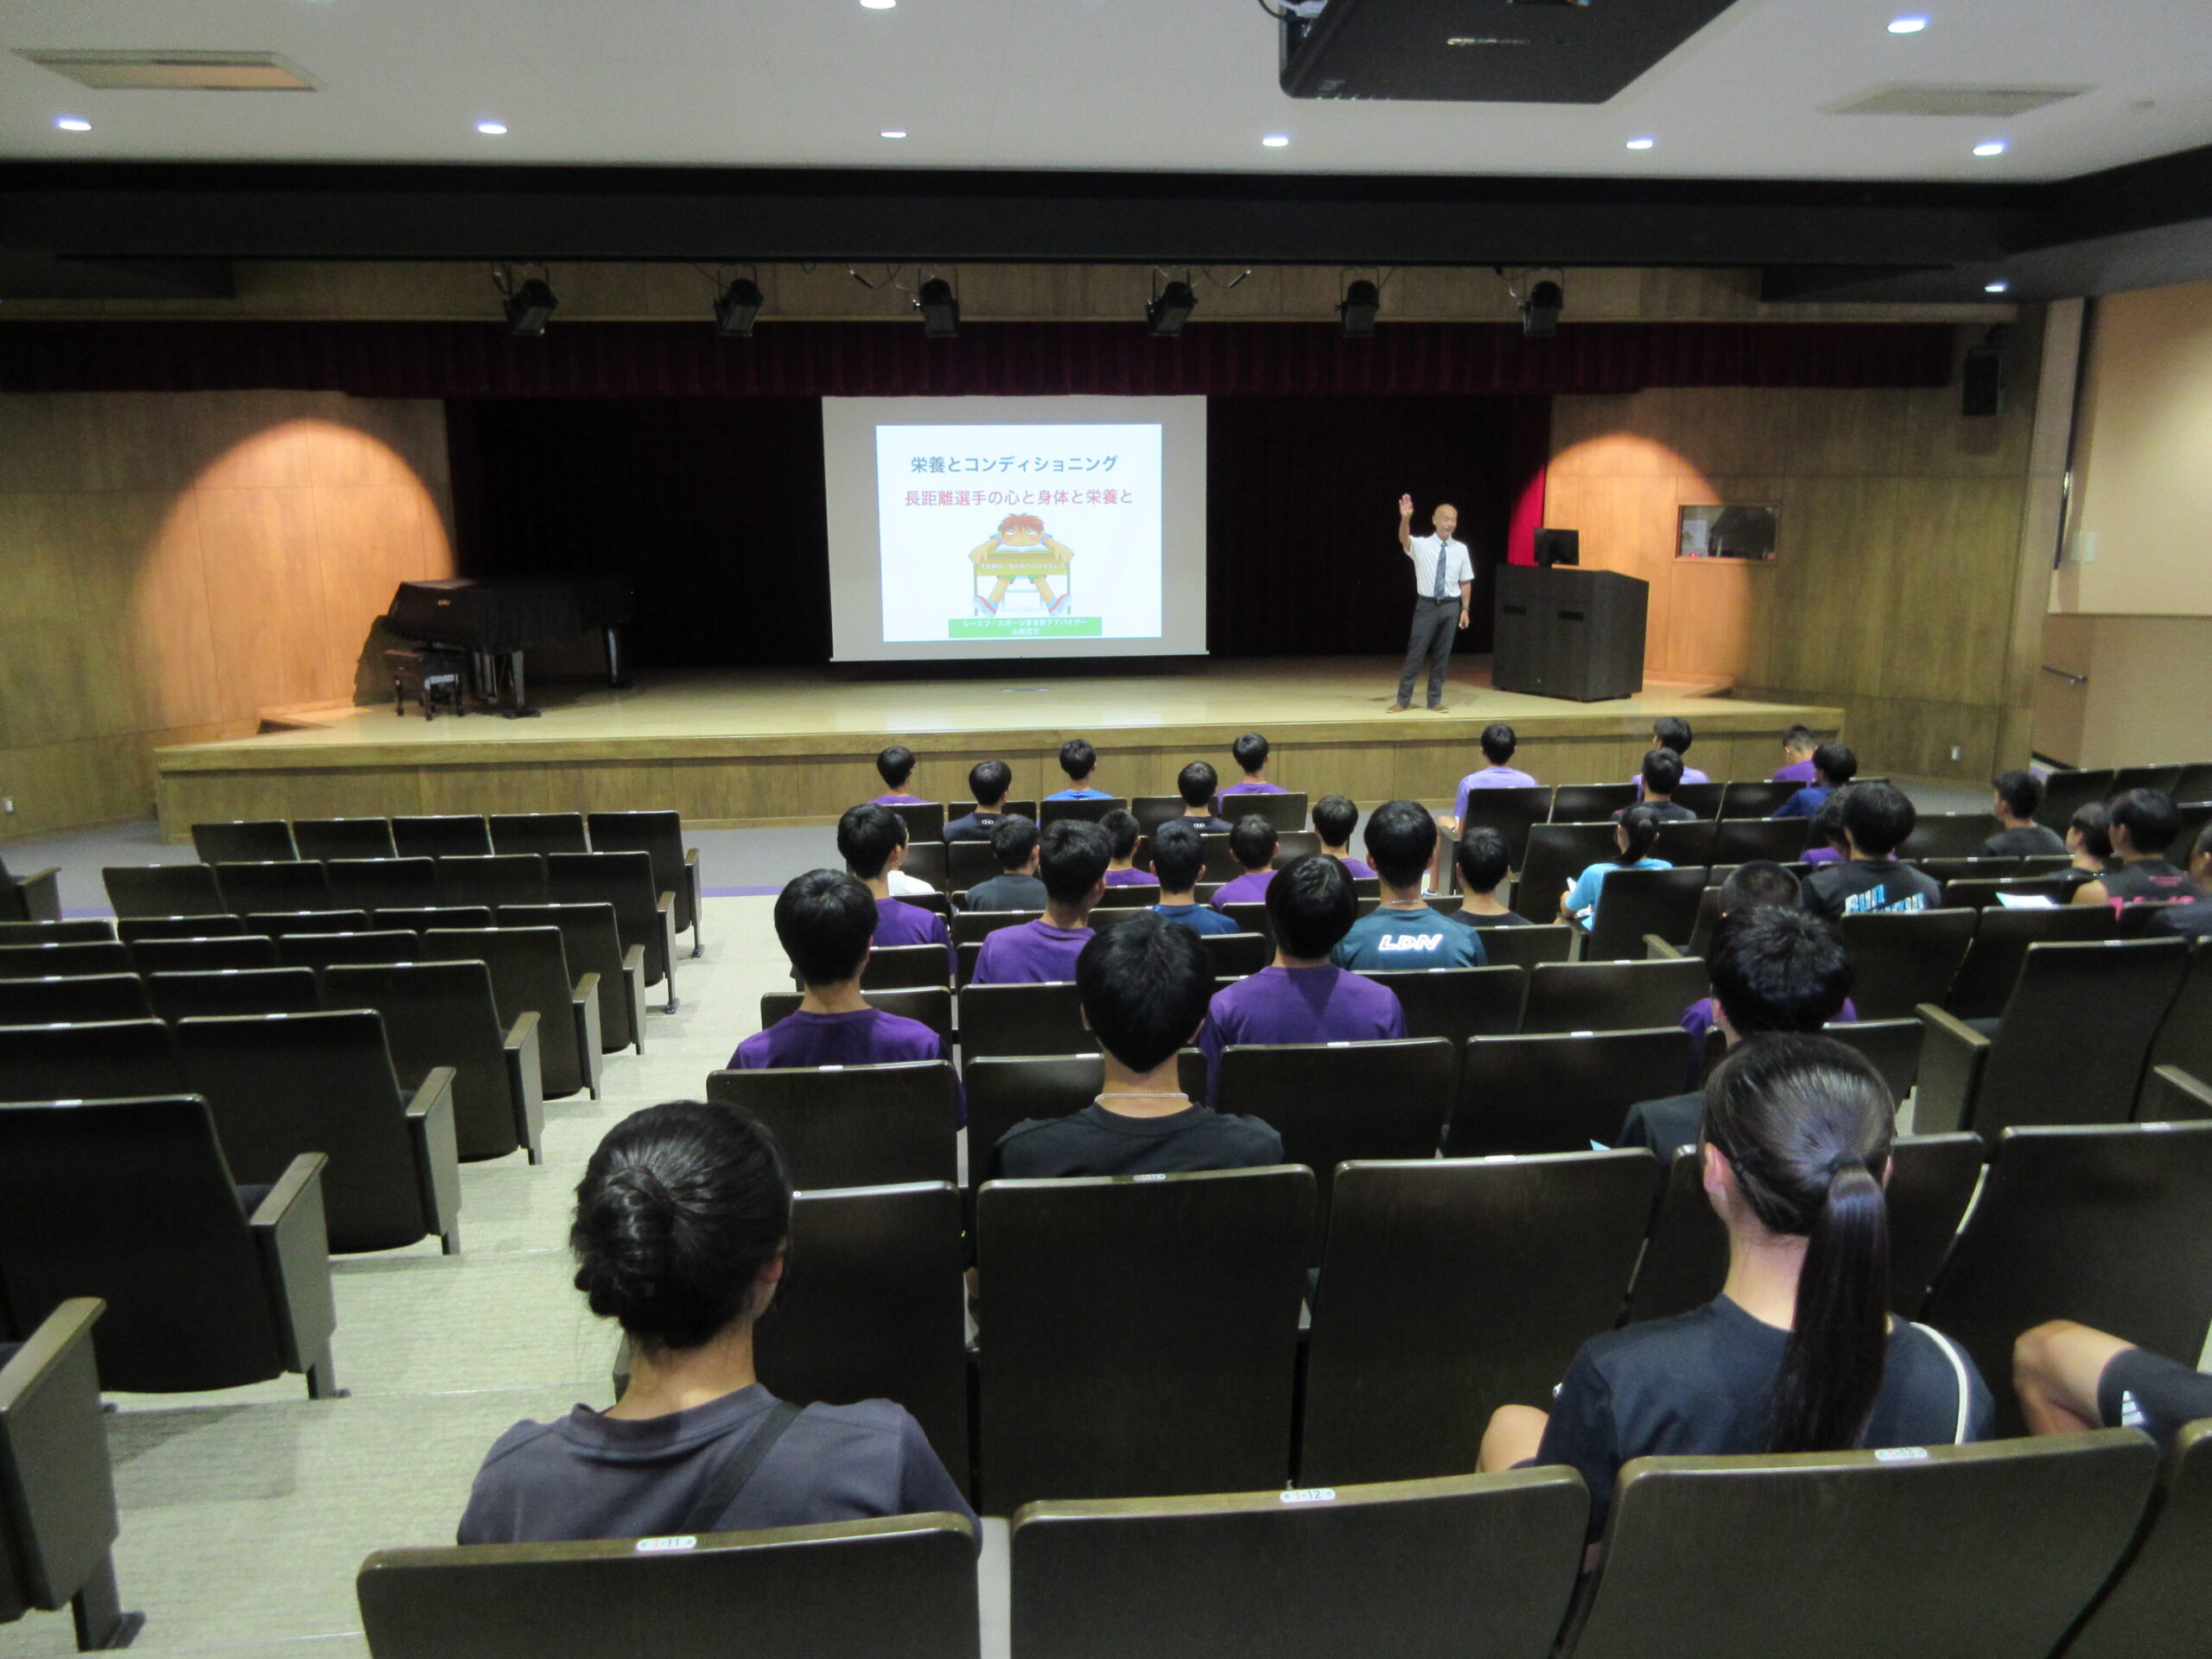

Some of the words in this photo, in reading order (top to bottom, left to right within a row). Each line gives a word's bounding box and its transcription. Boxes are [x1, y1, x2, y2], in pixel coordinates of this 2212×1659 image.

[911, 456, 1118, 474] 栄養とコンディショニング
[906, 489, 1134, 506] 長距離選手の心と身体と栄養と
[1378, 934, 1443, 950] LDN
